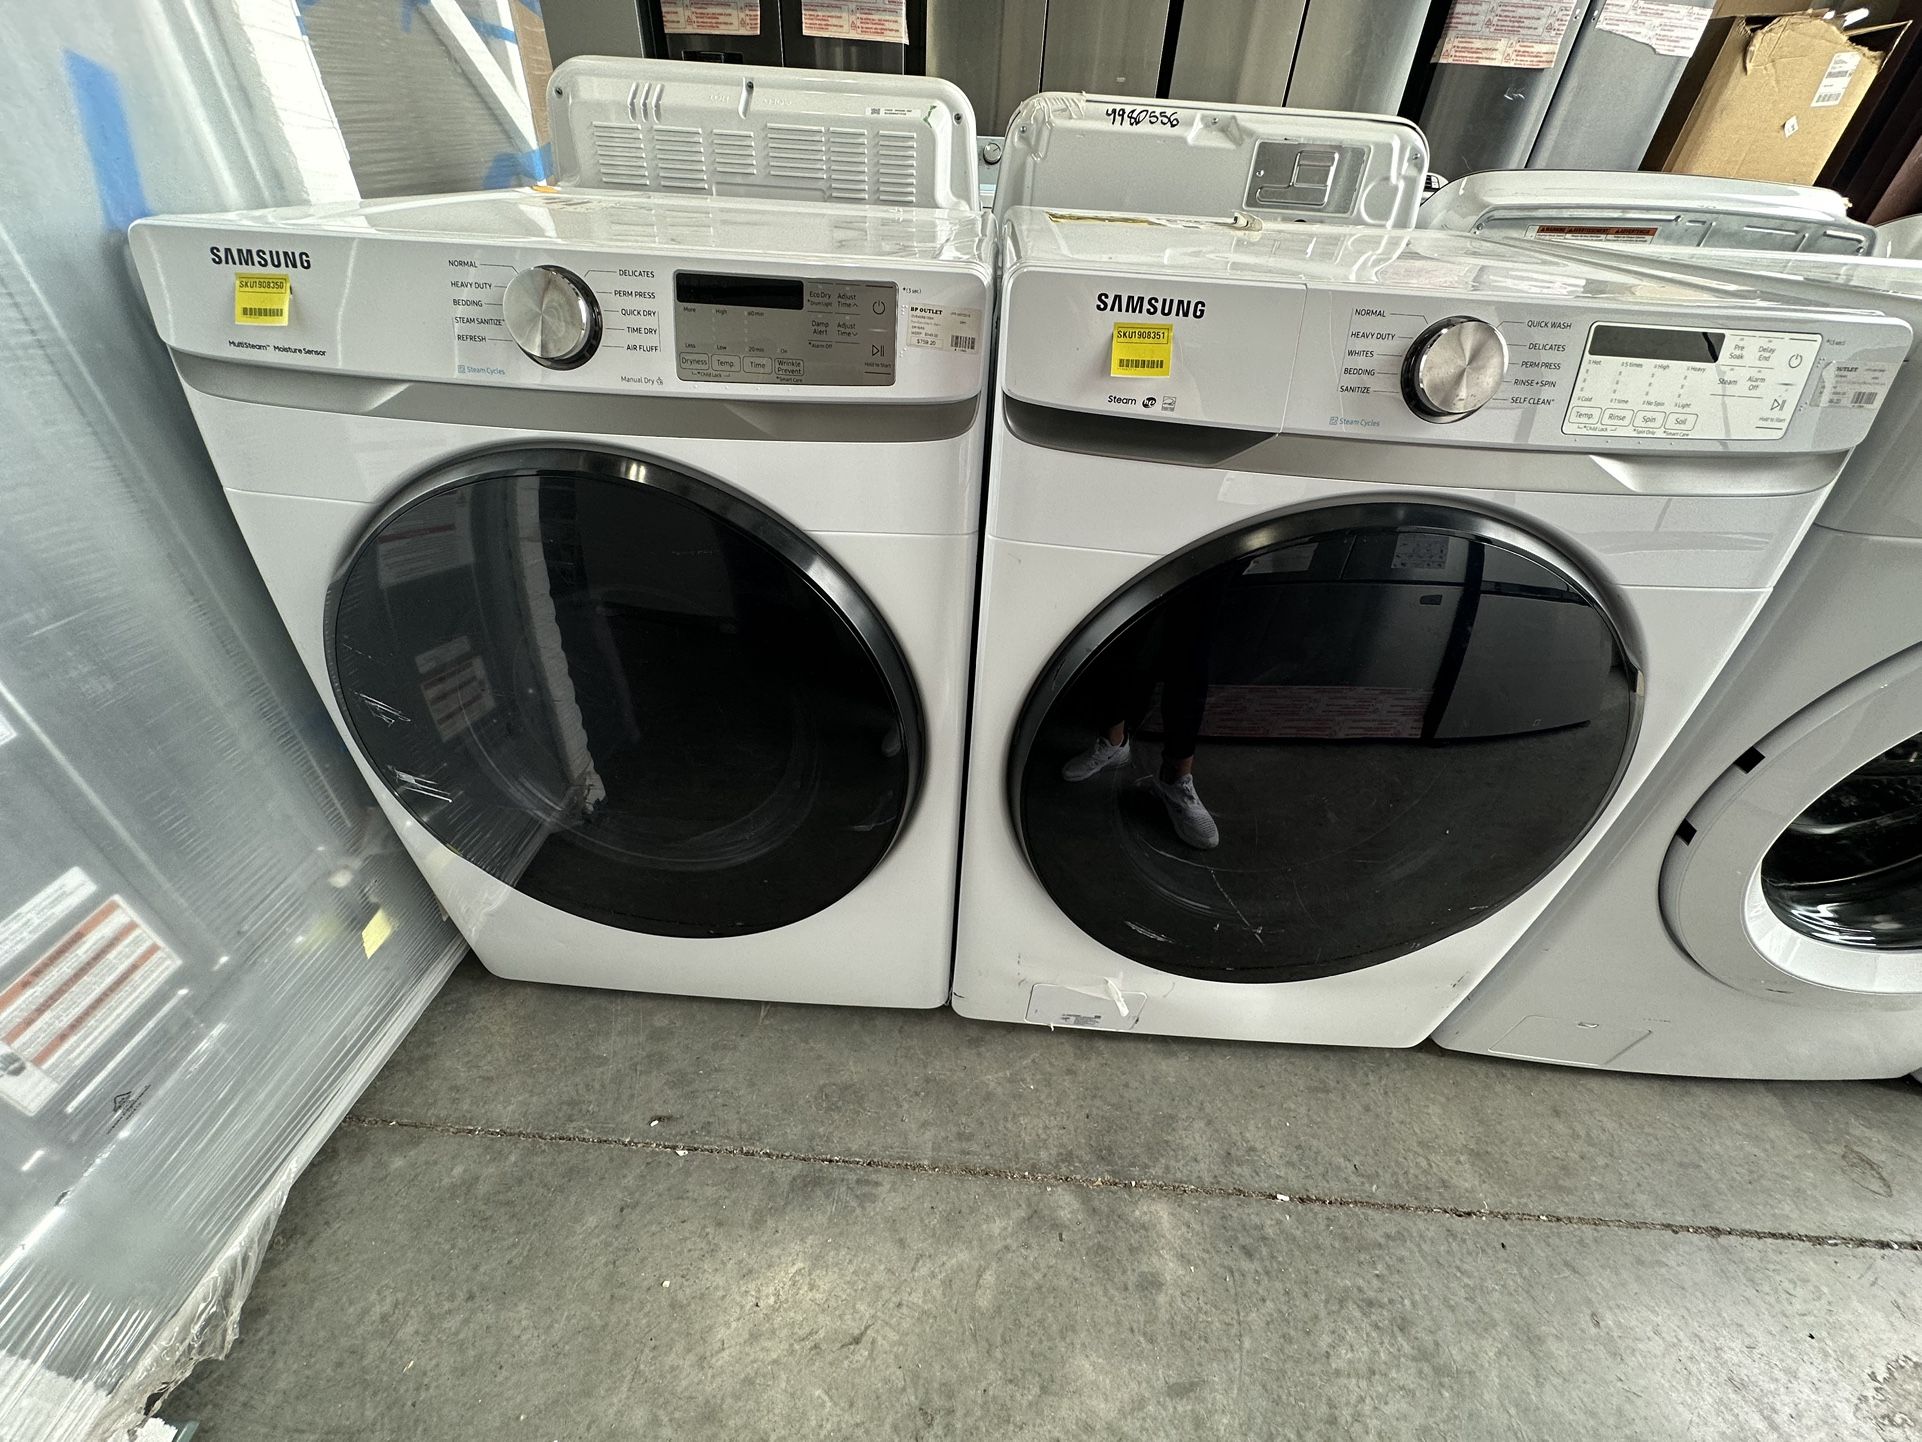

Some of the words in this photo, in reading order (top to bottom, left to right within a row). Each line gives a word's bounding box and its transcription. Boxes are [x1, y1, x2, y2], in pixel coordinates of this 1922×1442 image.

[1105, 108, 1180, 128] 4980556
[209, 246, 311, 270] SAMSUNG
[448, 259, 478, 268] NORMAL
[618, 269, 655, 279] DELICATES
[239, 280, 284, 290] SKU1908350
[450, 280, 473, 290] HEAVY
[474, 281, 492, 291] DUTY
[613, 289, 633, 299] PERM
[634, 290, 656, 300] PRESS
[820, 291, 832, 300] Dry
[837, 292, 857, 301] Adjust
[452, 298, 483, 308] BEDDING
[1095, 292, 1206, 319] SAMSUNG
[620, 308, 640, 318] QUICK
[642, 309, 657, 318] DRY
[715, 308, 728, 316] High
[919, 307, 943, 316] OUTLET
[1354, 308, 1387, 318] NORMAL
[455, 316, 477, 325] STEAM
[811, 320, 829, 329] Damp
[1526, 320, 1549, 330] QUICK
[1549, 321, 1573, 331] WASH
[626, 326, 642, 335] TIME
[643, 327, 658, 336] DRY
[837, 322, 856, 331] Adjust
[457, 334, 487, 343] REFRESH
[1116, 329, 1166, 341] SKU1908351
[1350, 330, 1375, 340] HEAVY
[1375, 332, 1396, 341] DUTY
[273, 344, 303, 355] Moisture
[303, 347, 327, 357] Sensor
[626, 344, 637, 353] AIR
[638, 344, 659, 354] FLUFF
[1528, 342, 1567, 353] DELICATES
[1733, 344, 1746, 352] Pre
[1758, 345, 1777, 355] Delay
[1347, 349, 1375, 358] WHITES
[1728, 353, 1745, 361] Soak
[1758, 354, 1771, 362] End
[681, 356, 708, 367] Dryness
[749, 360, 766, 370] Time
[777, 359, 802, 369] Wrinkle
[1520, 360, 1541, 369] PERM
[1540, 361, 1562, 371] PRESS
[466, 365, 487, 375] Steam
[486, 366, 506, 377] Cycles
[777, 367, 802, 376] Prevent
[1343, 366, 1376, 377] BEDDING
[1657, 363, 1671, 372] High
[620, 375, 643, 384] Manual
[643, 376, 655, 386] Dry
[1513, 378, 1535, 388] RINSE
[1540, 379, 1557, 389] SPIN
[1717, 377, 1738, 386] Steam
[1746, 375, 1766, 384] Alarm
[1339, 385, 1371, 395] SANITIZE
[1748, 383, 1760, 392] Off
[1107, 394, 1137, 406] Steam
[1510, 396, 1529, 405] SELF
[1575, 410, 1595, 420] Temp.
[1607, 412, 1627, 422] Rinse
[1641, 415, 1657, 424] Spin
[1339, 416, 1360, 426] Steam
[1359, 417, 1380, 428] Cycles
[1674, 416, 1688, 426] Soil
